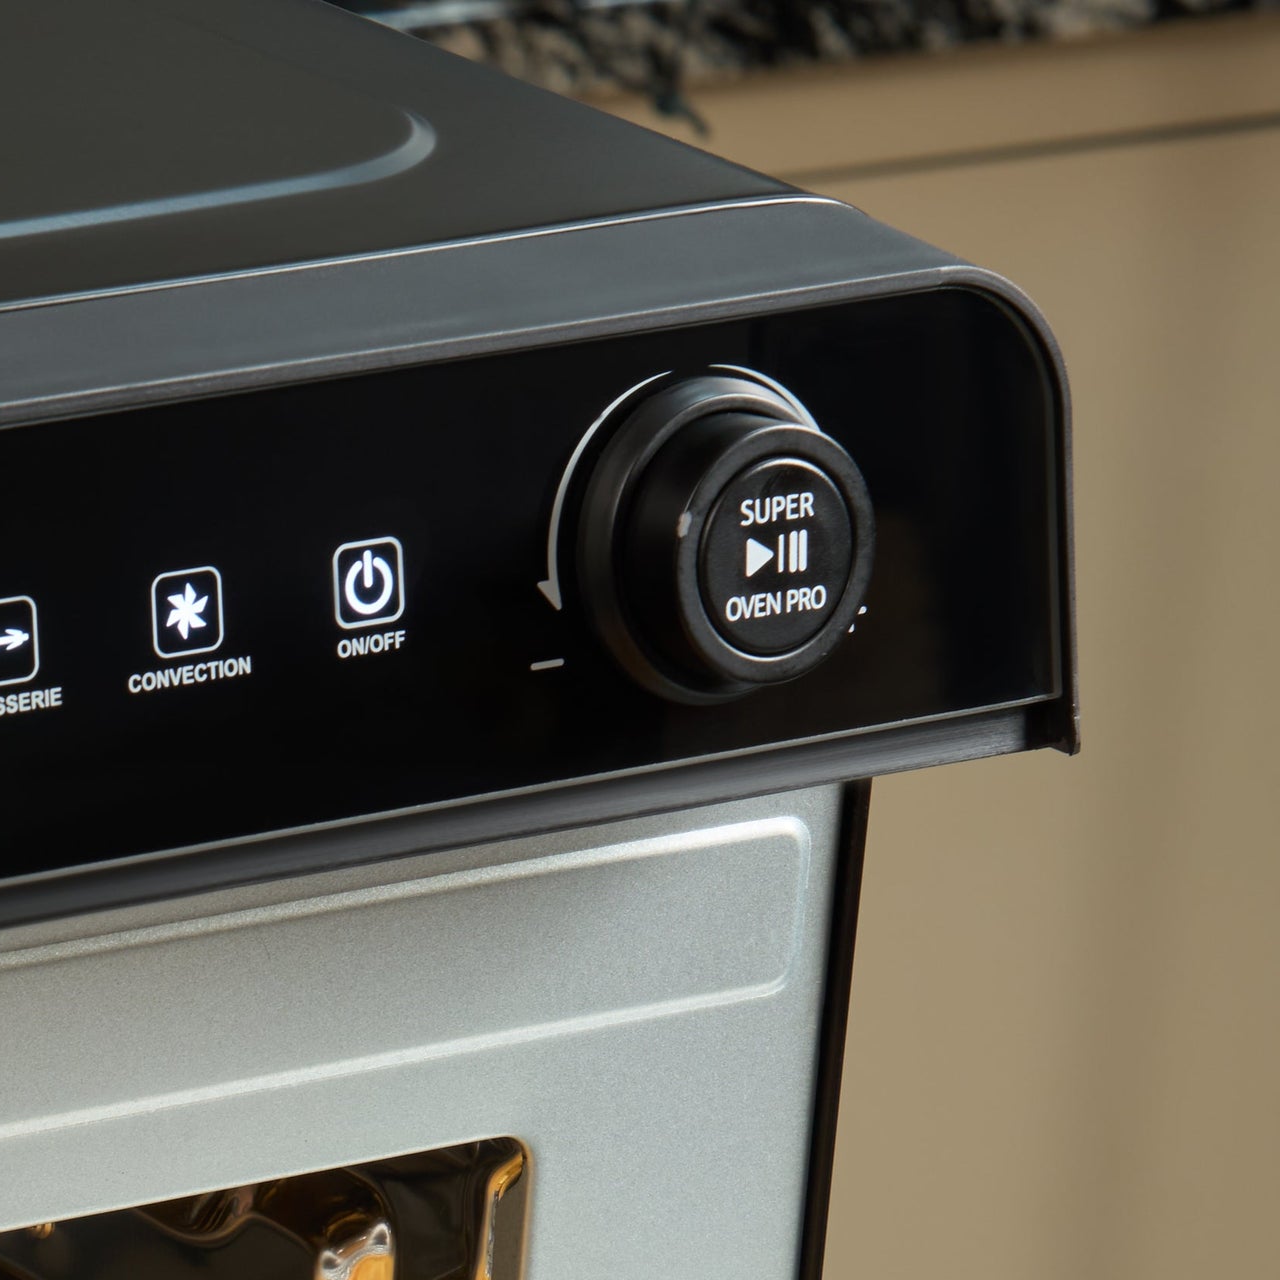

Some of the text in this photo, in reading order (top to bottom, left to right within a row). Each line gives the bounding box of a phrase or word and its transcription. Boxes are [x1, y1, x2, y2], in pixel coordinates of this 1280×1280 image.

[741, 492, 814, 526] SUPER
[726, 585, 826, 621] OVEN PRO
[338, 630, 406, 659] ON/OFF
[128, 656, 252, 694] CONVECTION
